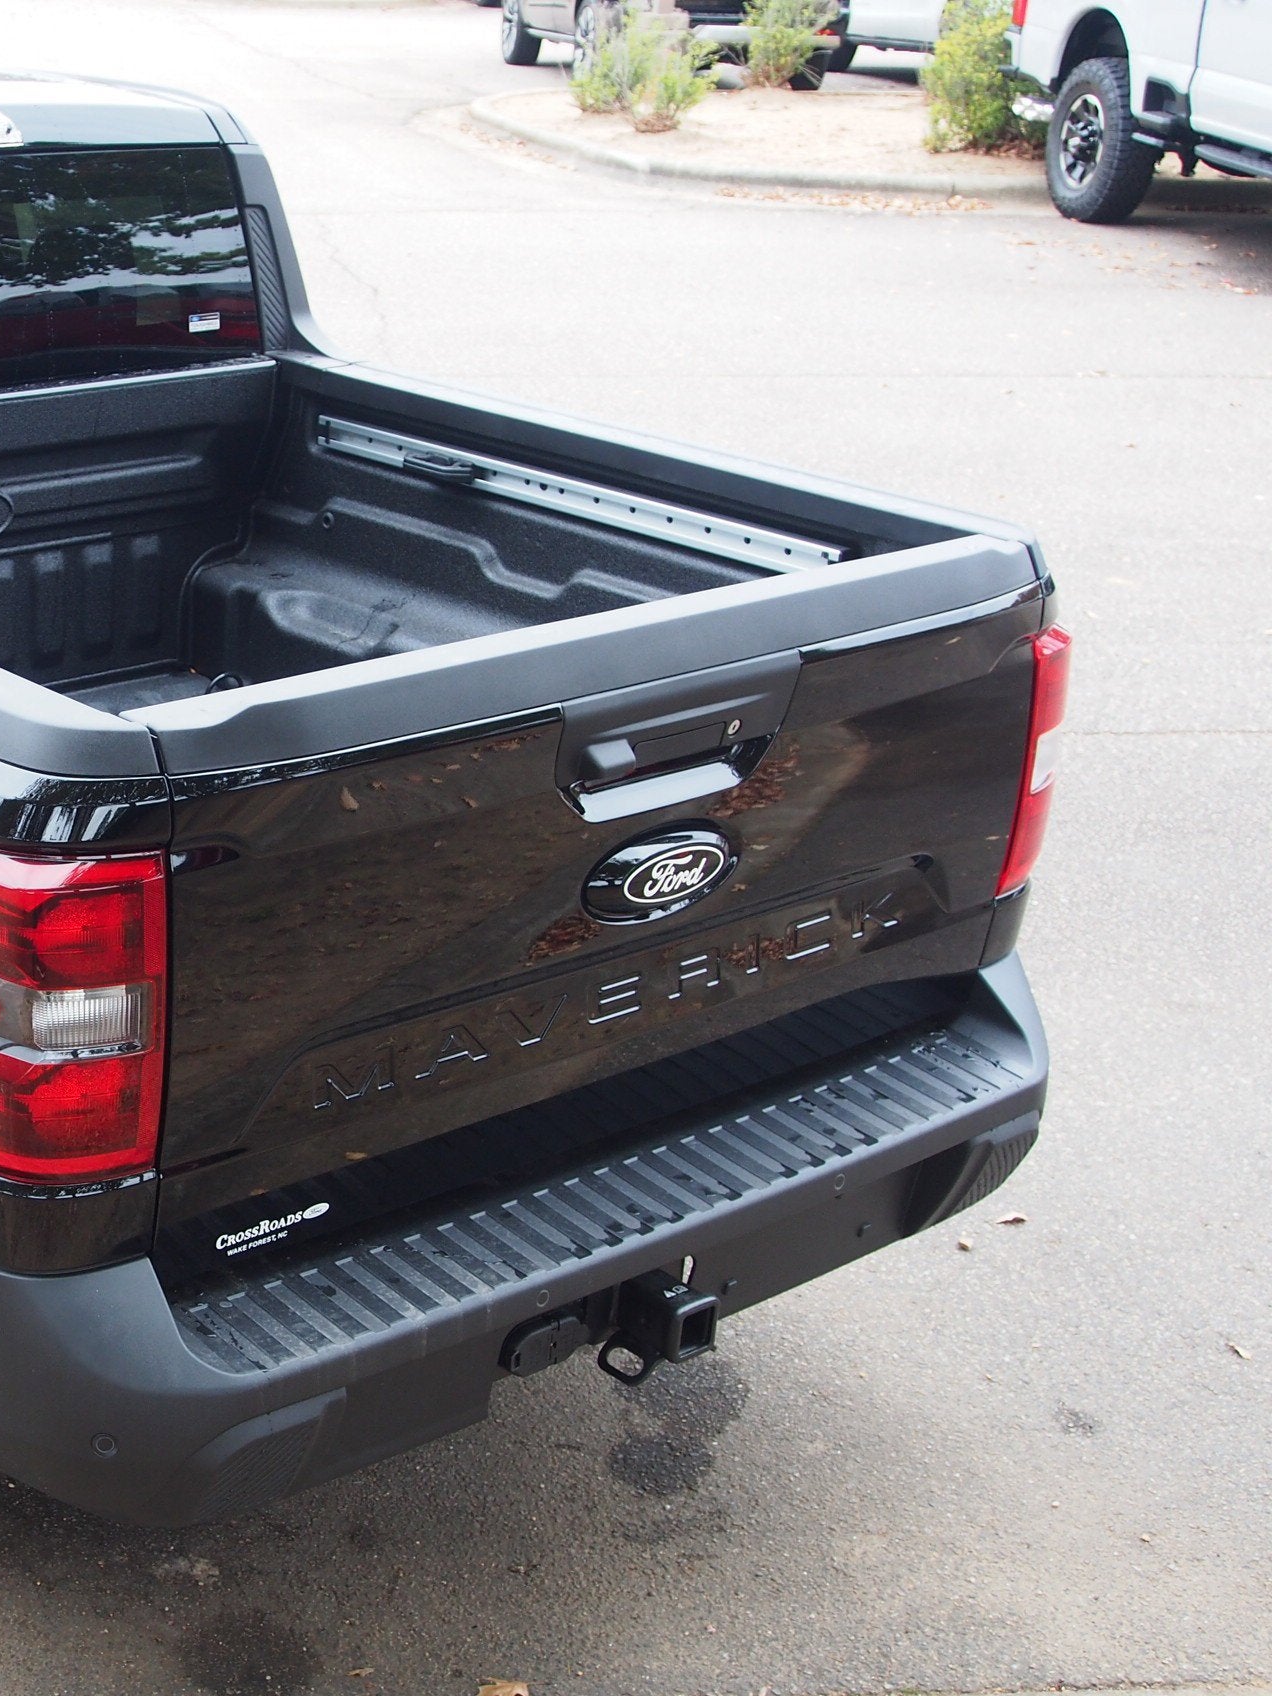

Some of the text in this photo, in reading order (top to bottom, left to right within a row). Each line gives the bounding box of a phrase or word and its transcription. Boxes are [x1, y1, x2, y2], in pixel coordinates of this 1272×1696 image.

[643, 854, 707, 898] Ford
[313, 892, 900, 1110] MAVERICK
[227, 1230, 288, 1257] WAKE FOREST, NC
